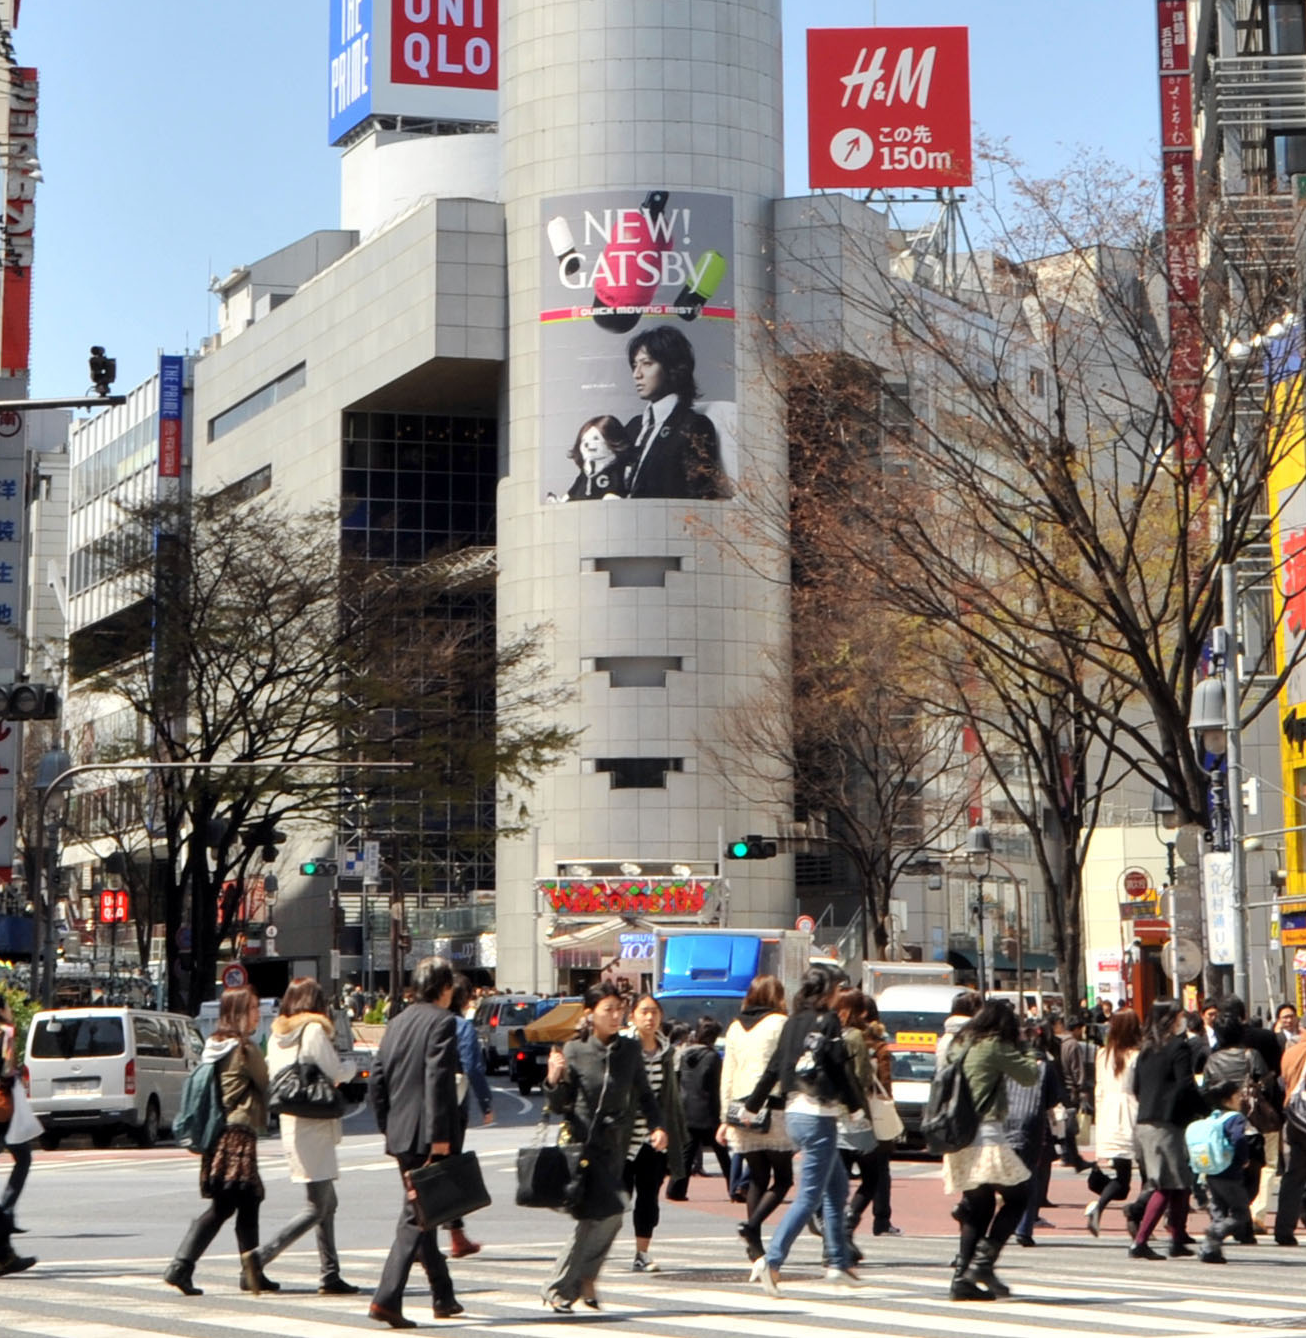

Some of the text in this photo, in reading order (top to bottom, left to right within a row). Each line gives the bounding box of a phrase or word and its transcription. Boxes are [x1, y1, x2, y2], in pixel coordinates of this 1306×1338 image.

[330, 31, 369, 120] PRIME
[403, 32, 492, 80] QLO
[840, 45, 937, 110] H&M
[879, 125, 933, 145] この先
[879, 146, 952, 171] 150m
[584, 208, 692, 246] NEW!
[559, 251, 714, 293] GATSBY
